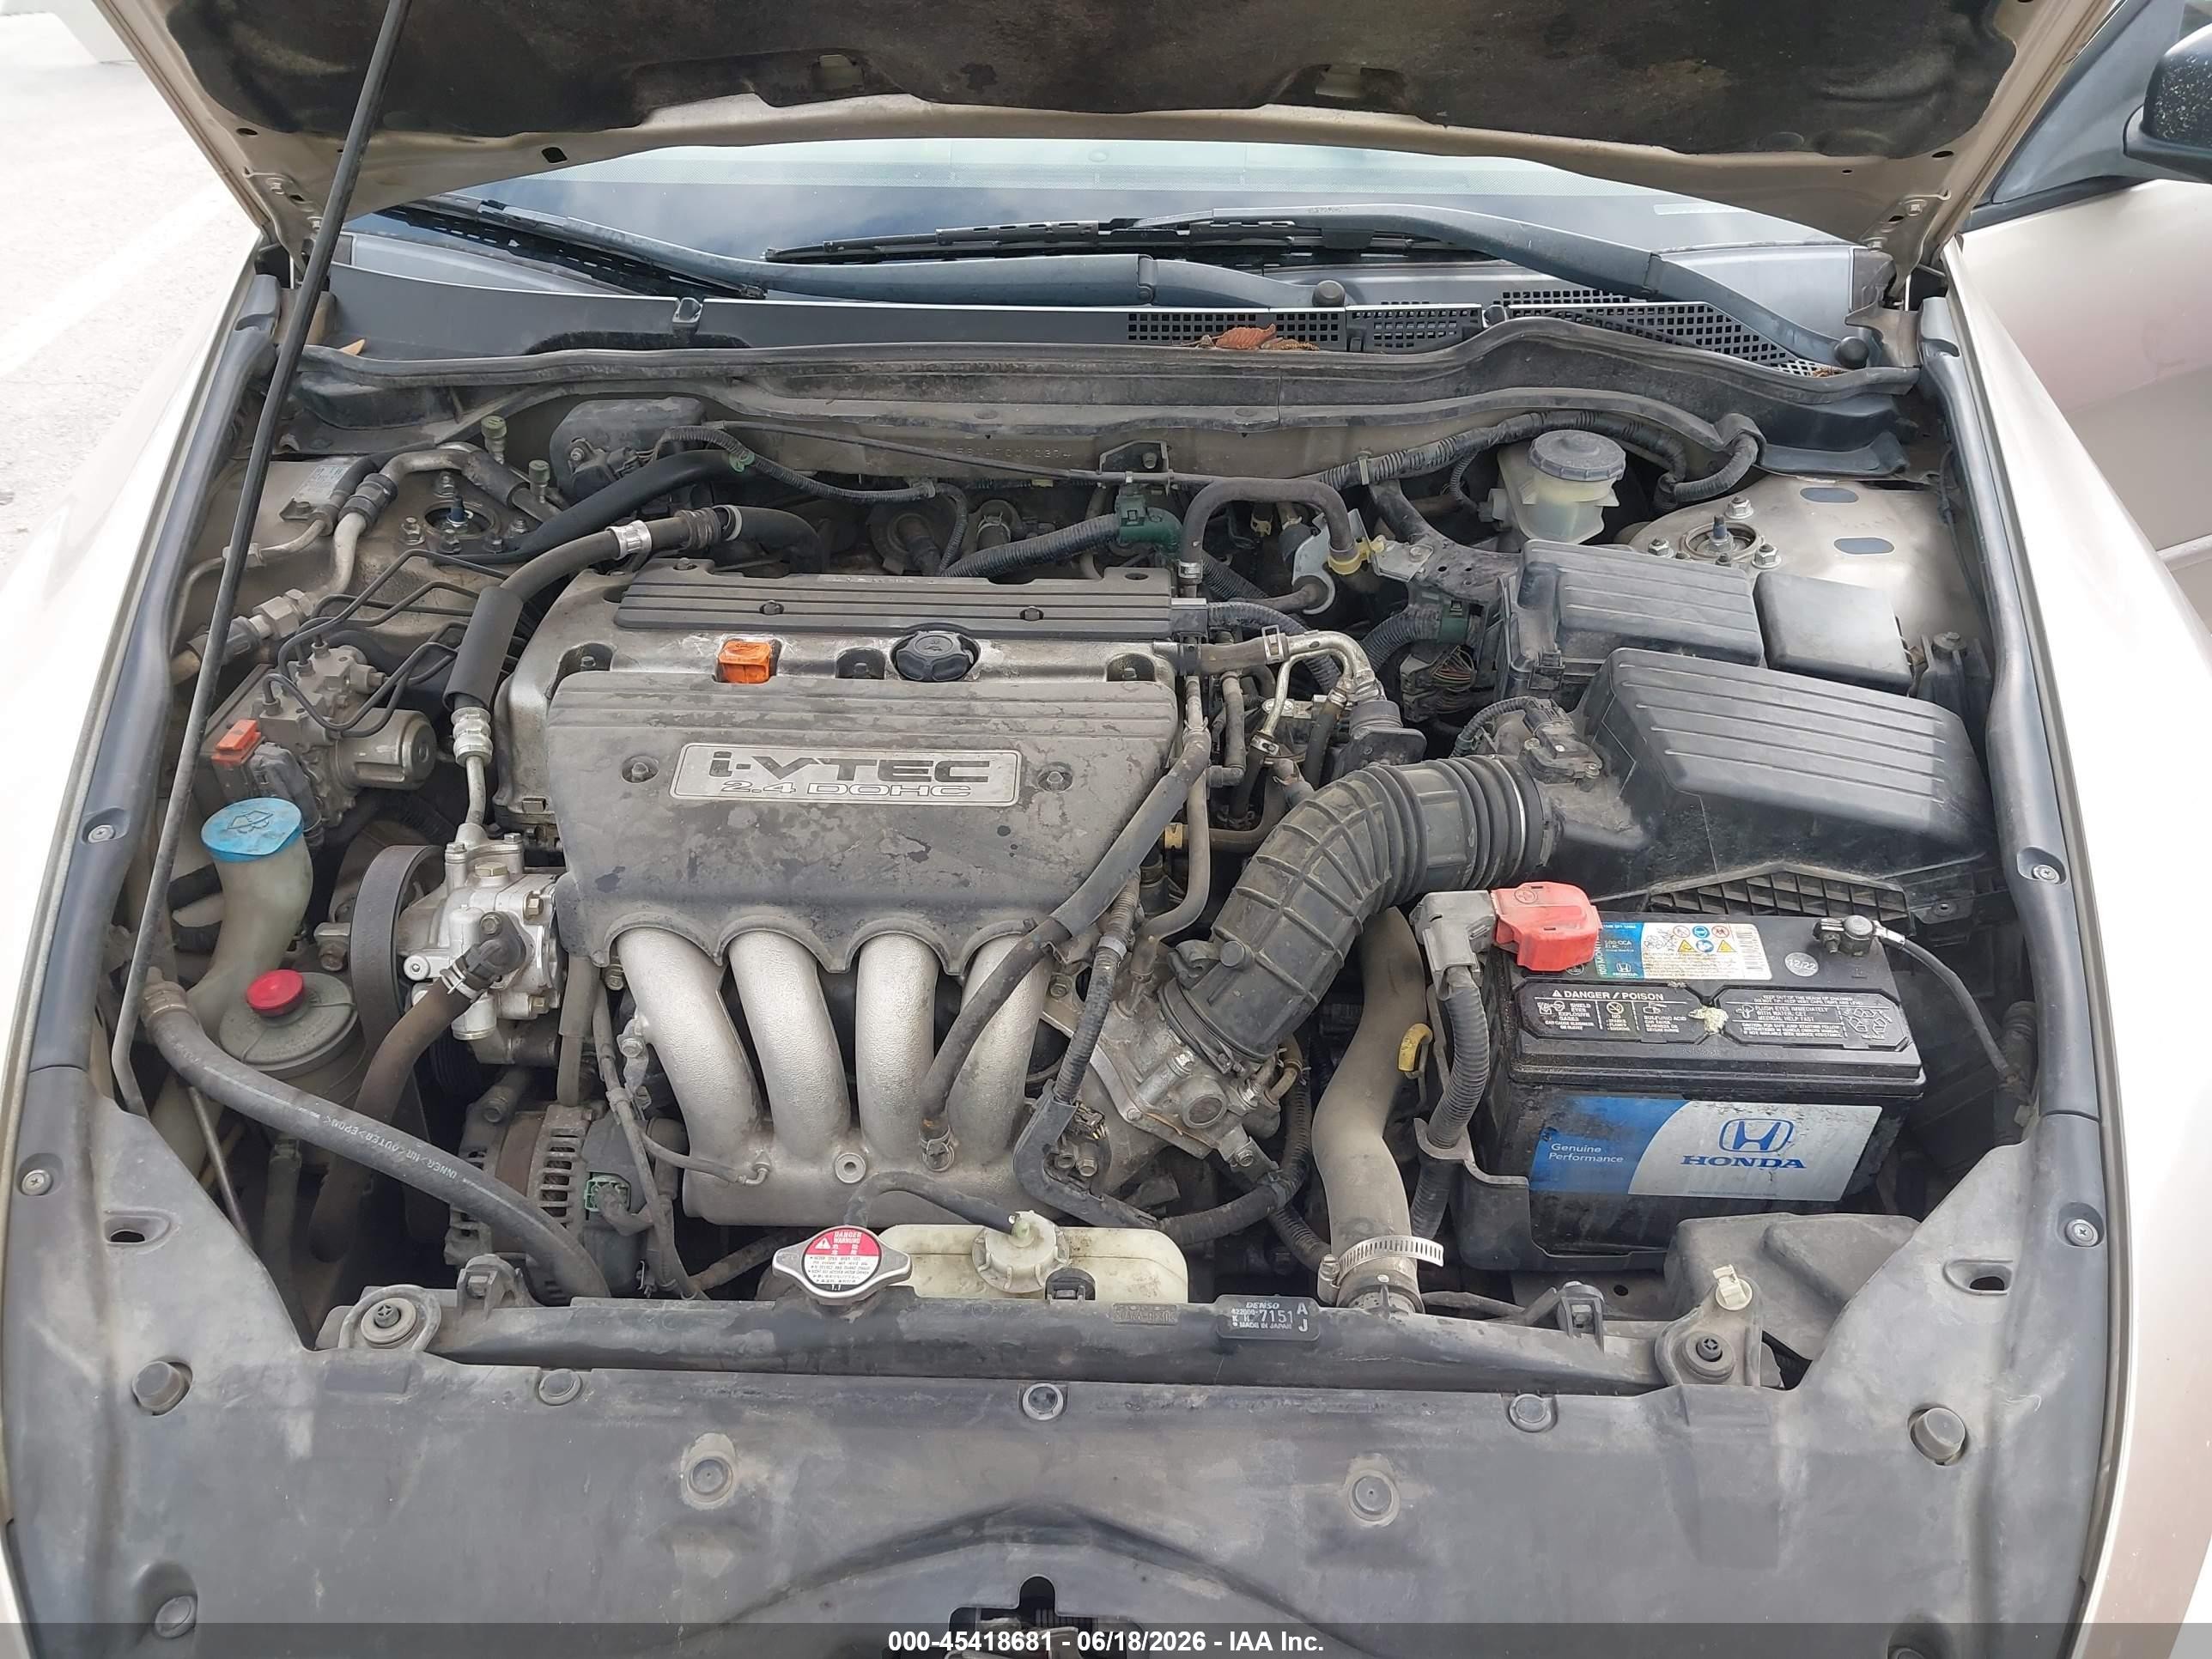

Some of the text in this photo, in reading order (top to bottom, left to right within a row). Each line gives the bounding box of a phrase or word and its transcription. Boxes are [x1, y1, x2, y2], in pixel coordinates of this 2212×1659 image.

[708, 750, 990, 782] i-VTEC
[721, 780, 971, 797] 2.4 DOHC
[1789, 959, 1816, 970] 12/22
[1564, 990, 1611, 1000] DANGER
[1621, 993, 1664, 1001] POISON
[1550, 1143, 1601, 1153] Genuine
[1549, 1152, 1624, 1164] Performance
[1680, 1155, 1807, 1169] HONDA
[1297, 1302, 1309, 1316] A
[1297, 1318, 1309, 1332] J
